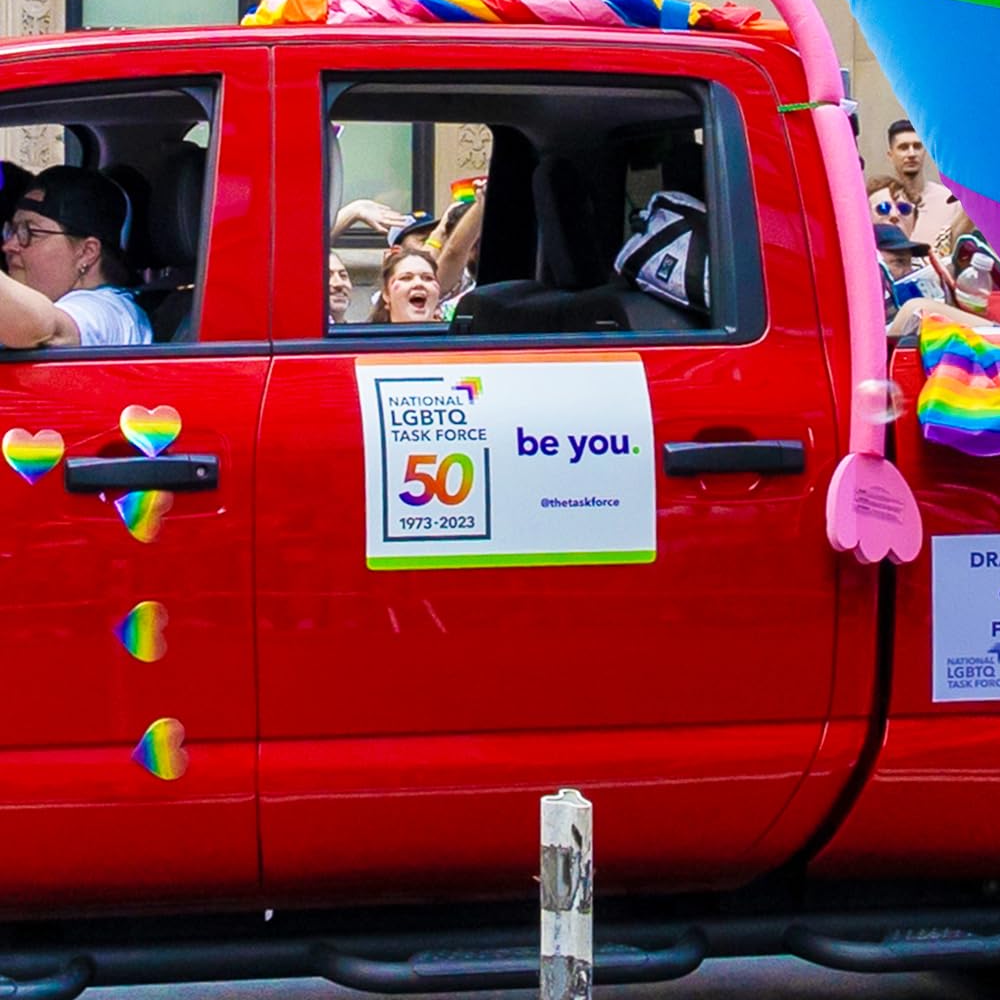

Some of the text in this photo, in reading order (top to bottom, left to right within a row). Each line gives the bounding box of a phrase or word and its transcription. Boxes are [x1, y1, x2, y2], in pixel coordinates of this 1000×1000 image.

[388, 395, 464, 407] NATIONAL
[390, 408, 468, 427] LGBTQ
[391, 428, 488, 442] TASK FORCE
[516, 426, 641, 464] be you.
[398, 452, 475, 507] 50
[540, 496, 620, 509] @thetaskforce
[946, 656, 995, 666] NATIONAL
[946, 665, 997, 679] LGBTQ
[947, 679, 973, 688] TASK
